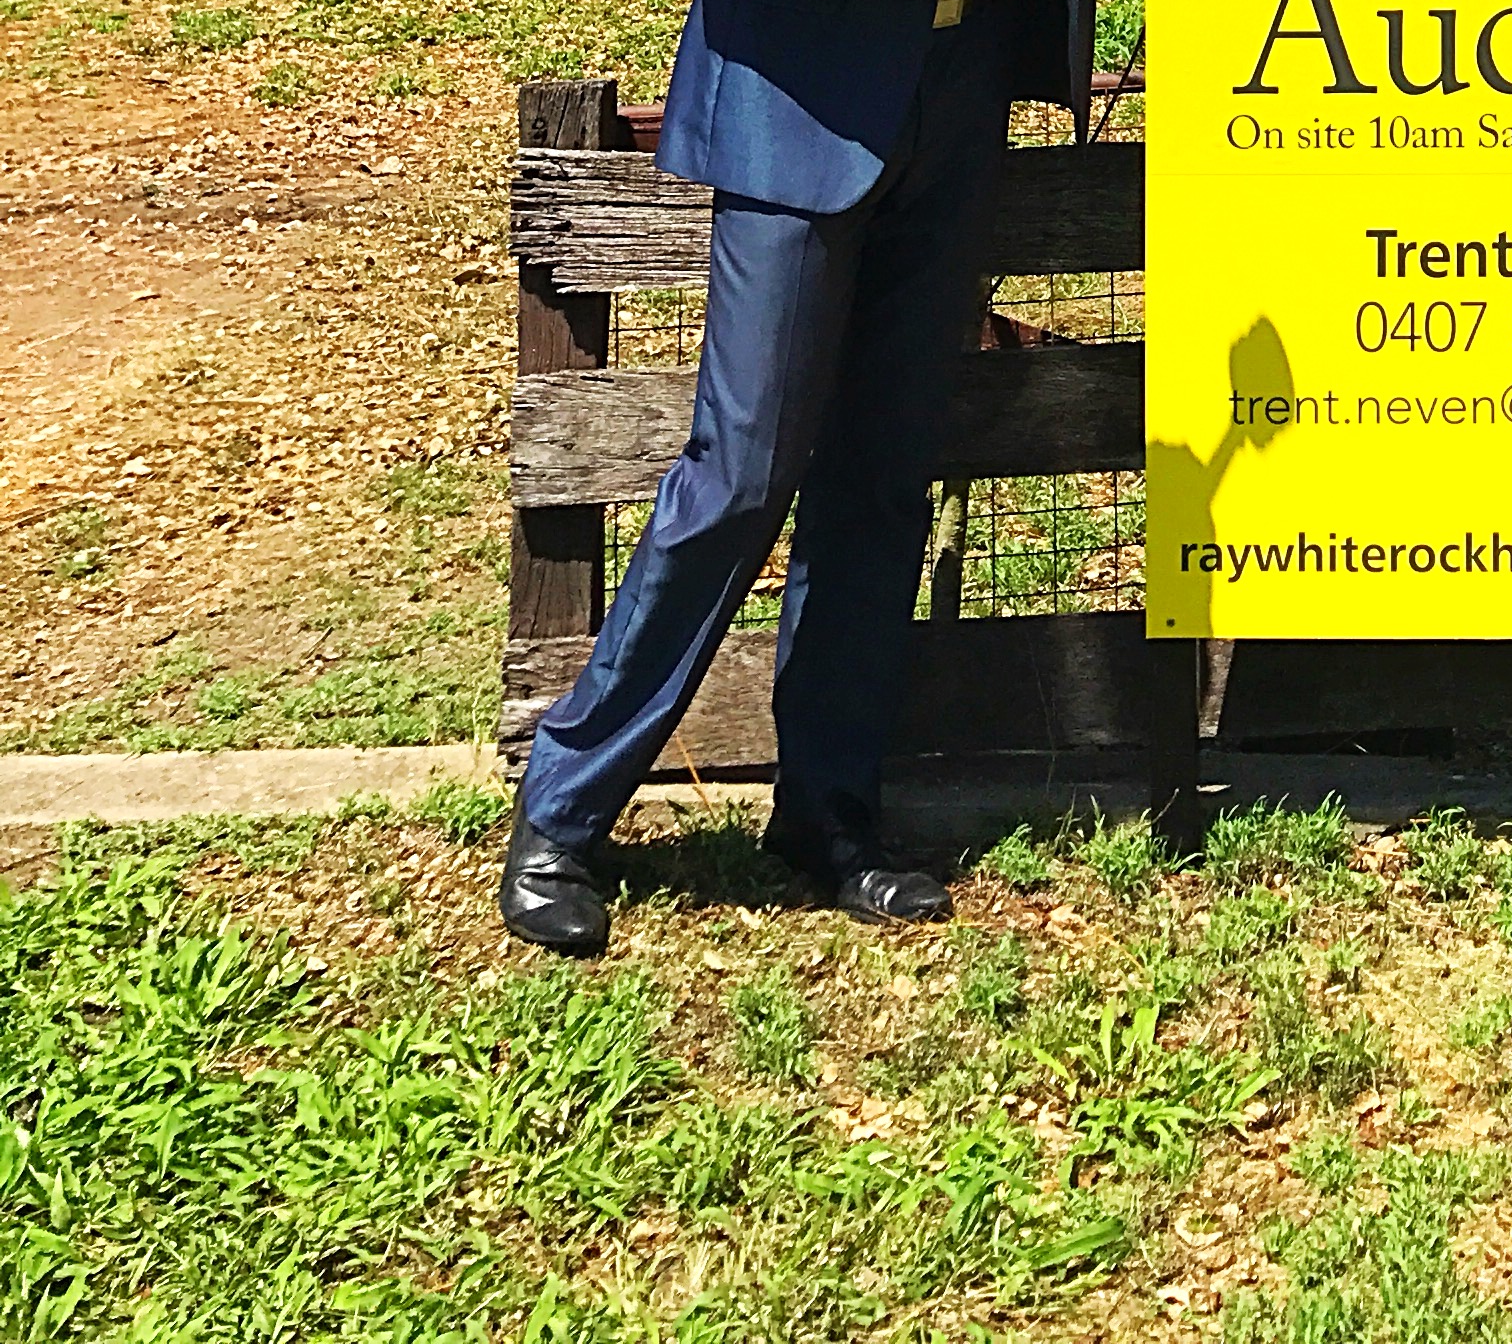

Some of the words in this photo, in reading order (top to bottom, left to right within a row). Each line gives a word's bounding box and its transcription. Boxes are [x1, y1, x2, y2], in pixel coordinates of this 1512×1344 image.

[1226, 114, 1284, 150] On
[1297, 115, 1355, 149] site
[1369, 115, 1465, 149] 10am
[1355, 300, 1487, 353] 0407
